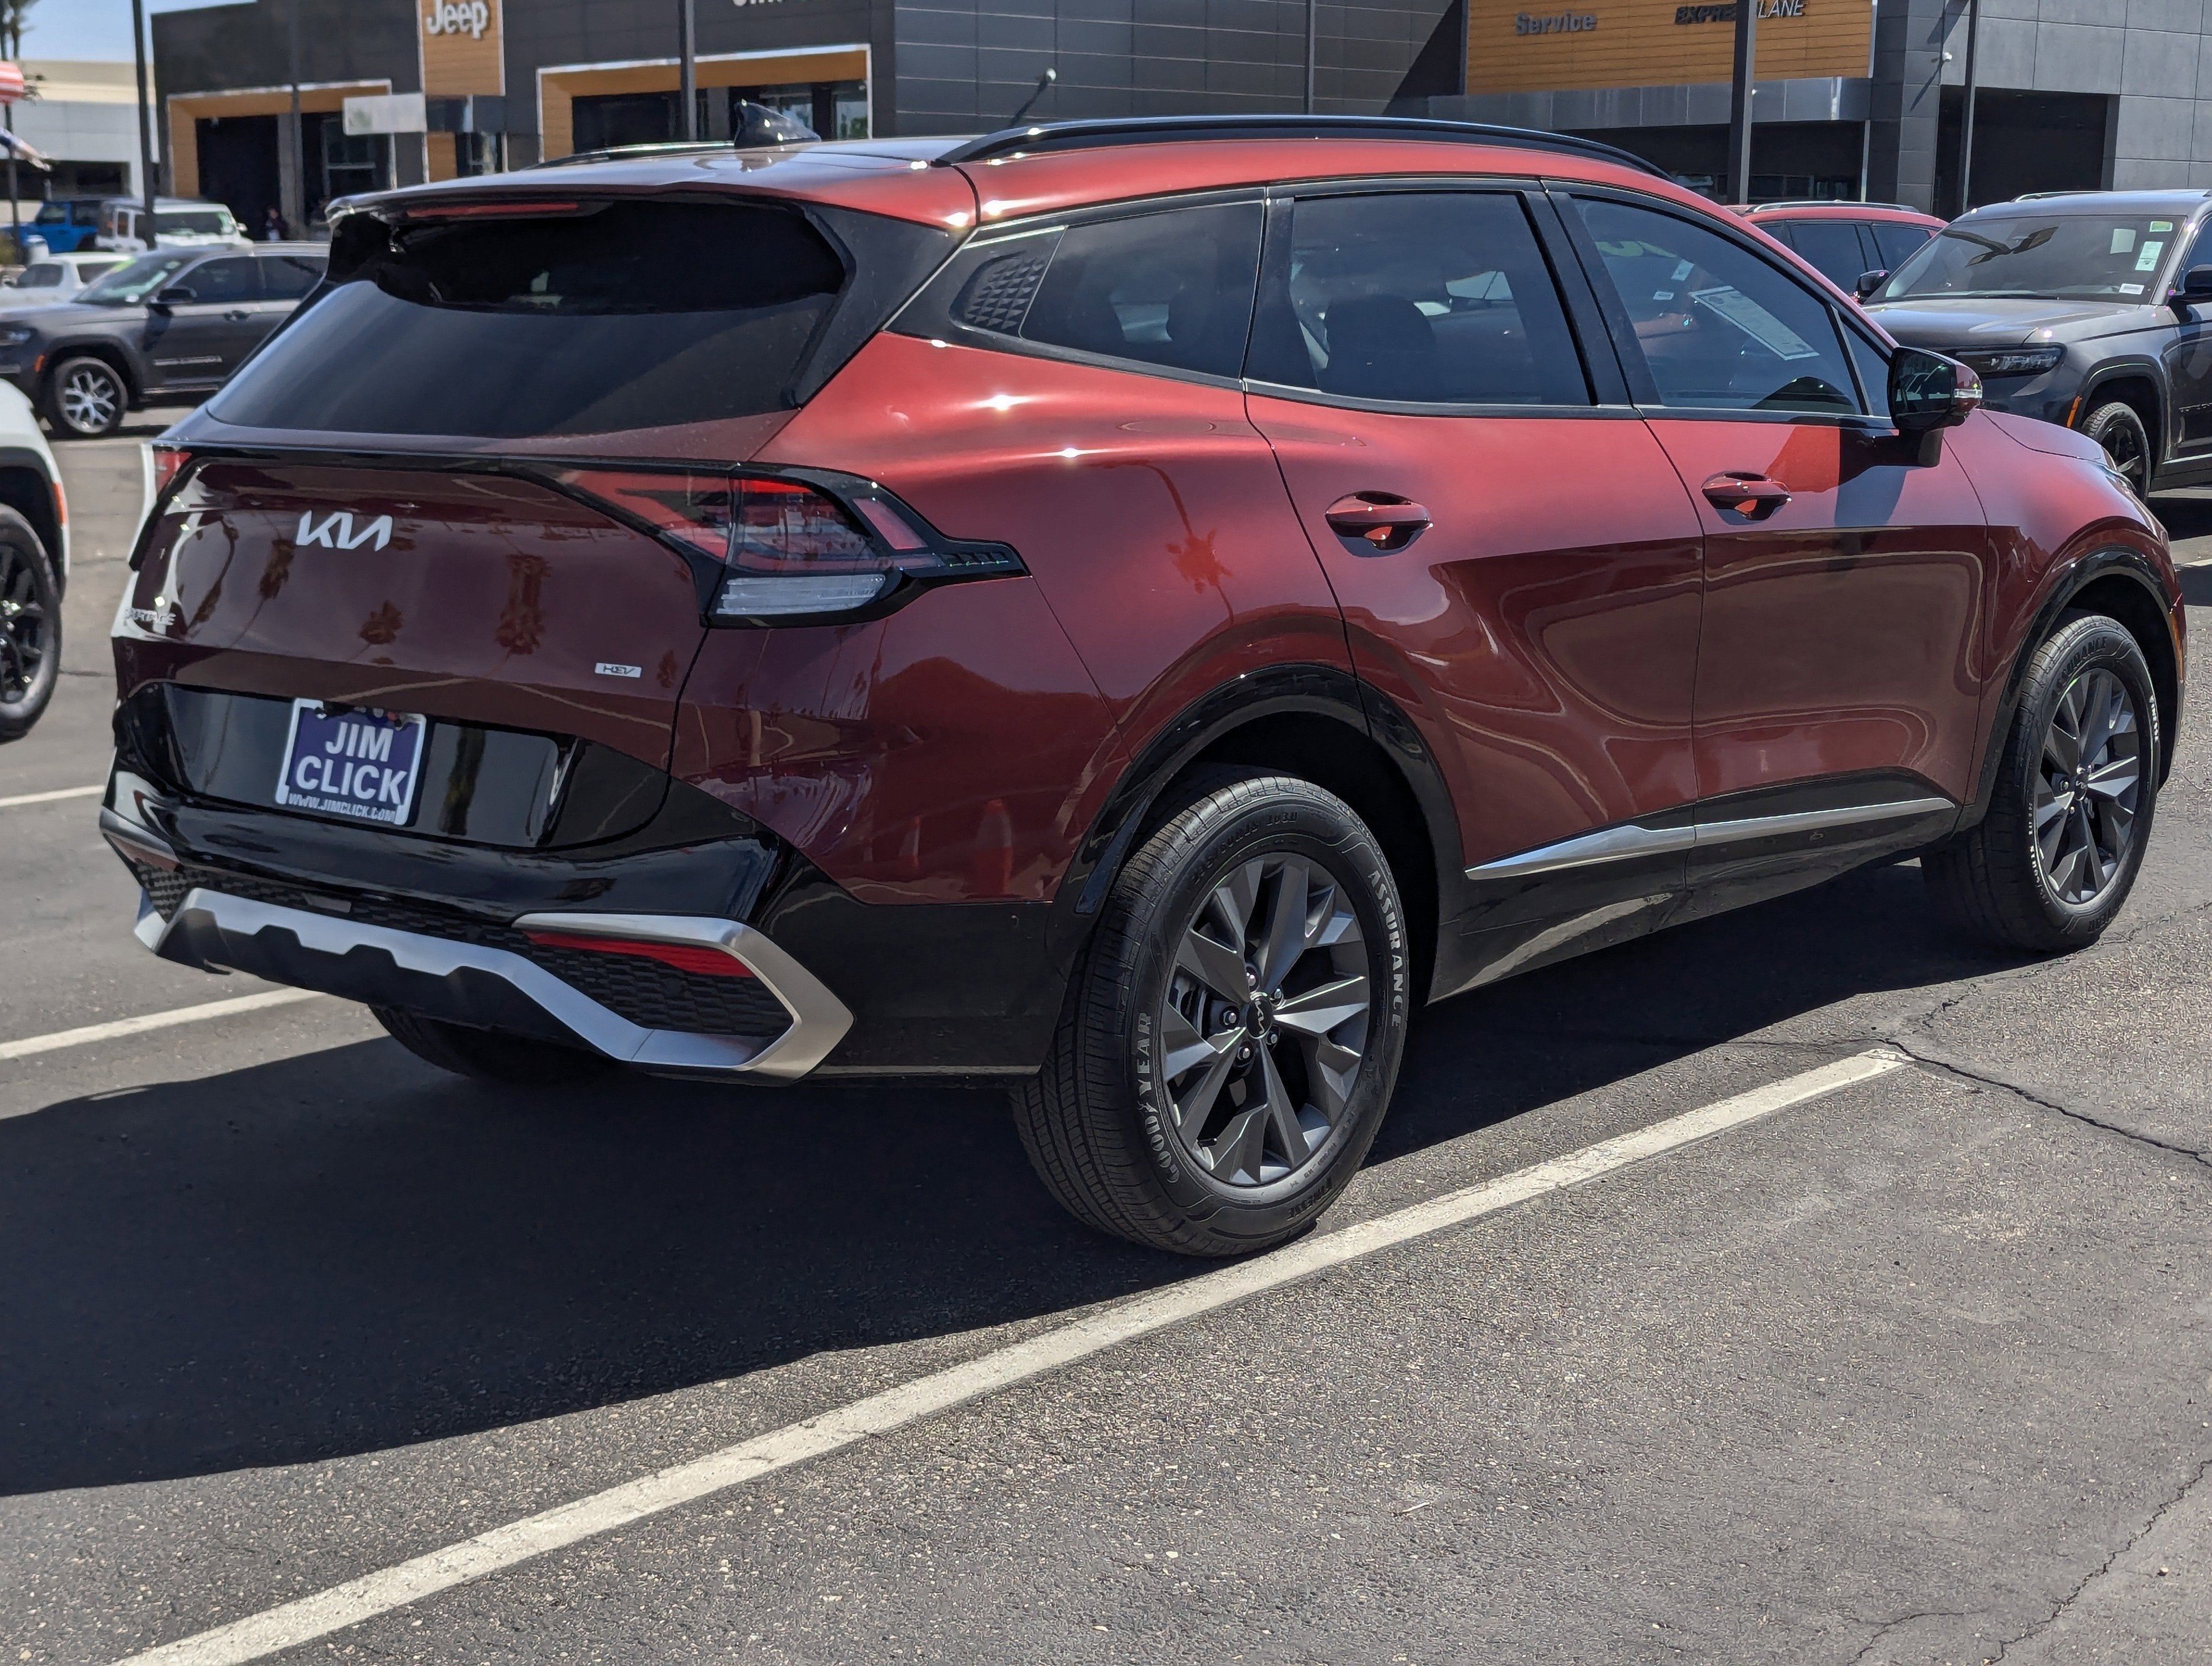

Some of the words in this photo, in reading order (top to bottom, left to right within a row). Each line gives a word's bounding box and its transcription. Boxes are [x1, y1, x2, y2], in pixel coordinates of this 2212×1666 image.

[426, 0, 488, 40] Jeep
[1516, 9, 1597, 36] Service
[1675, 3, 1737, 25] EXPRE
[1758, 0, 1804, 18] LANE
[295, 510, 393, 552] KIA
[603, 665, 636, 675] HEV
[325, 722, 394, 762] JIM
[296, 755, 408, 805] CLICK
[1367, 870, 1404, 1027] ASSURANCE
[1137, 1013, 1180, 1183] GOODYEAR
